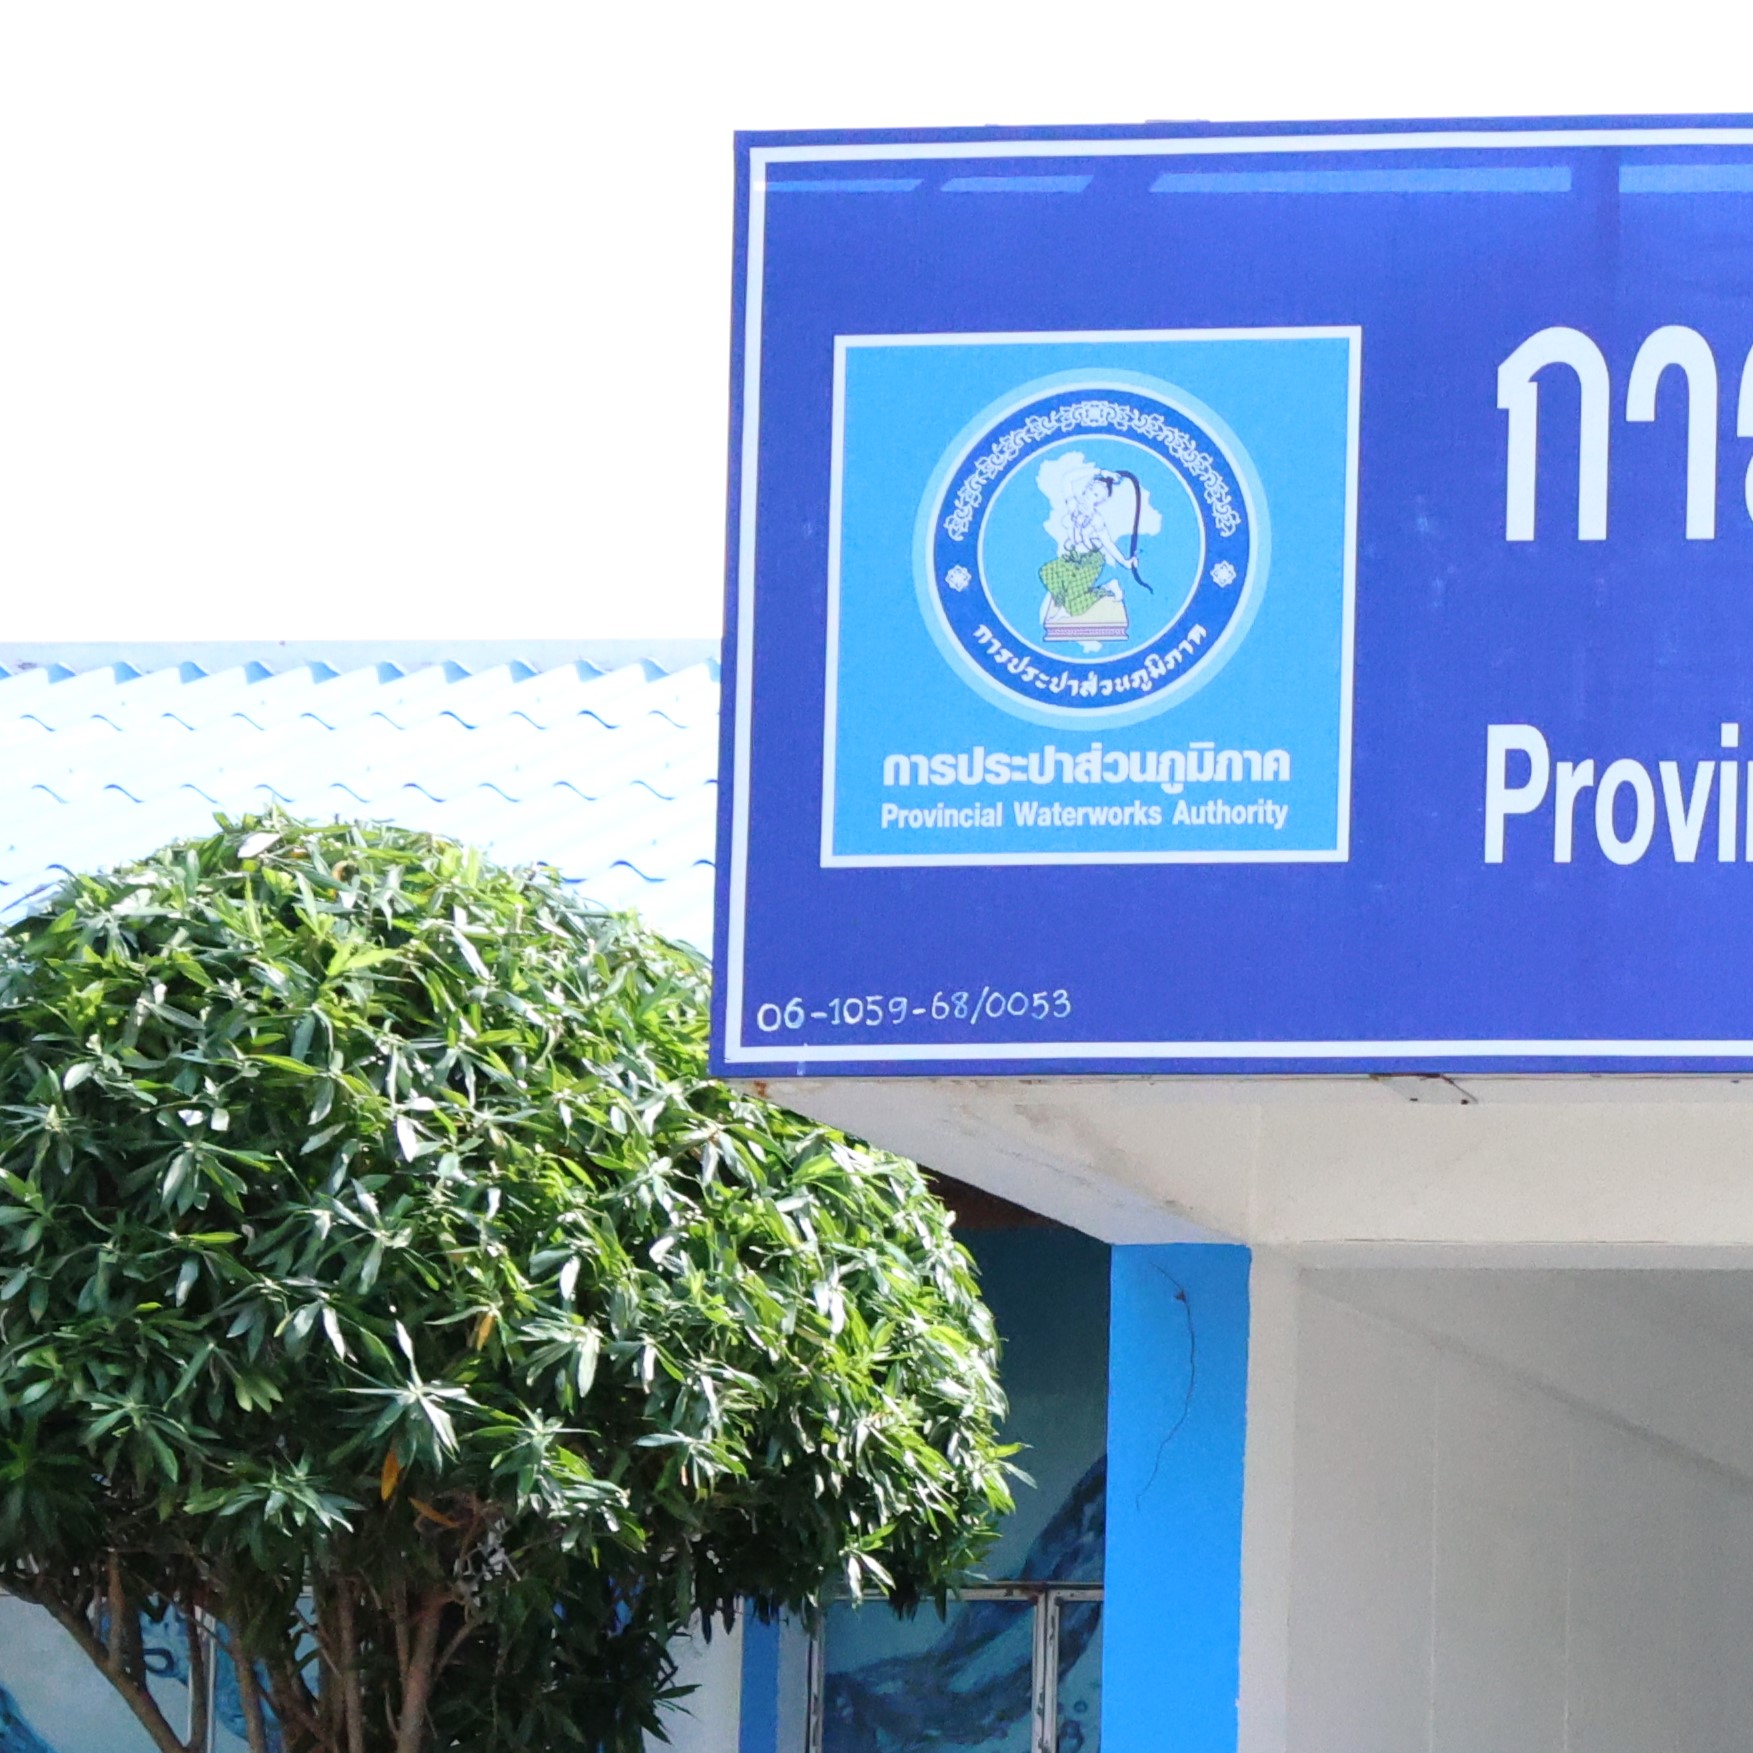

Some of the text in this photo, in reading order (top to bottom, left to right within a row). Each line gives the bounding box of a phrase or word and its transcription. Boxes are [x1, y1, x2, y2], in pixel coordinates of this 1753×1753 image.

[972, 622, 1208, 698] การประปาส่วนภูมิภาค
[883, 742, 1291, 794] การประปาส่วนภูมิภาค
[881, 799, 1289, 831] Provincial Waterworks Authority
[756, 986, 1072, 1032] 06-1059-68/0053
